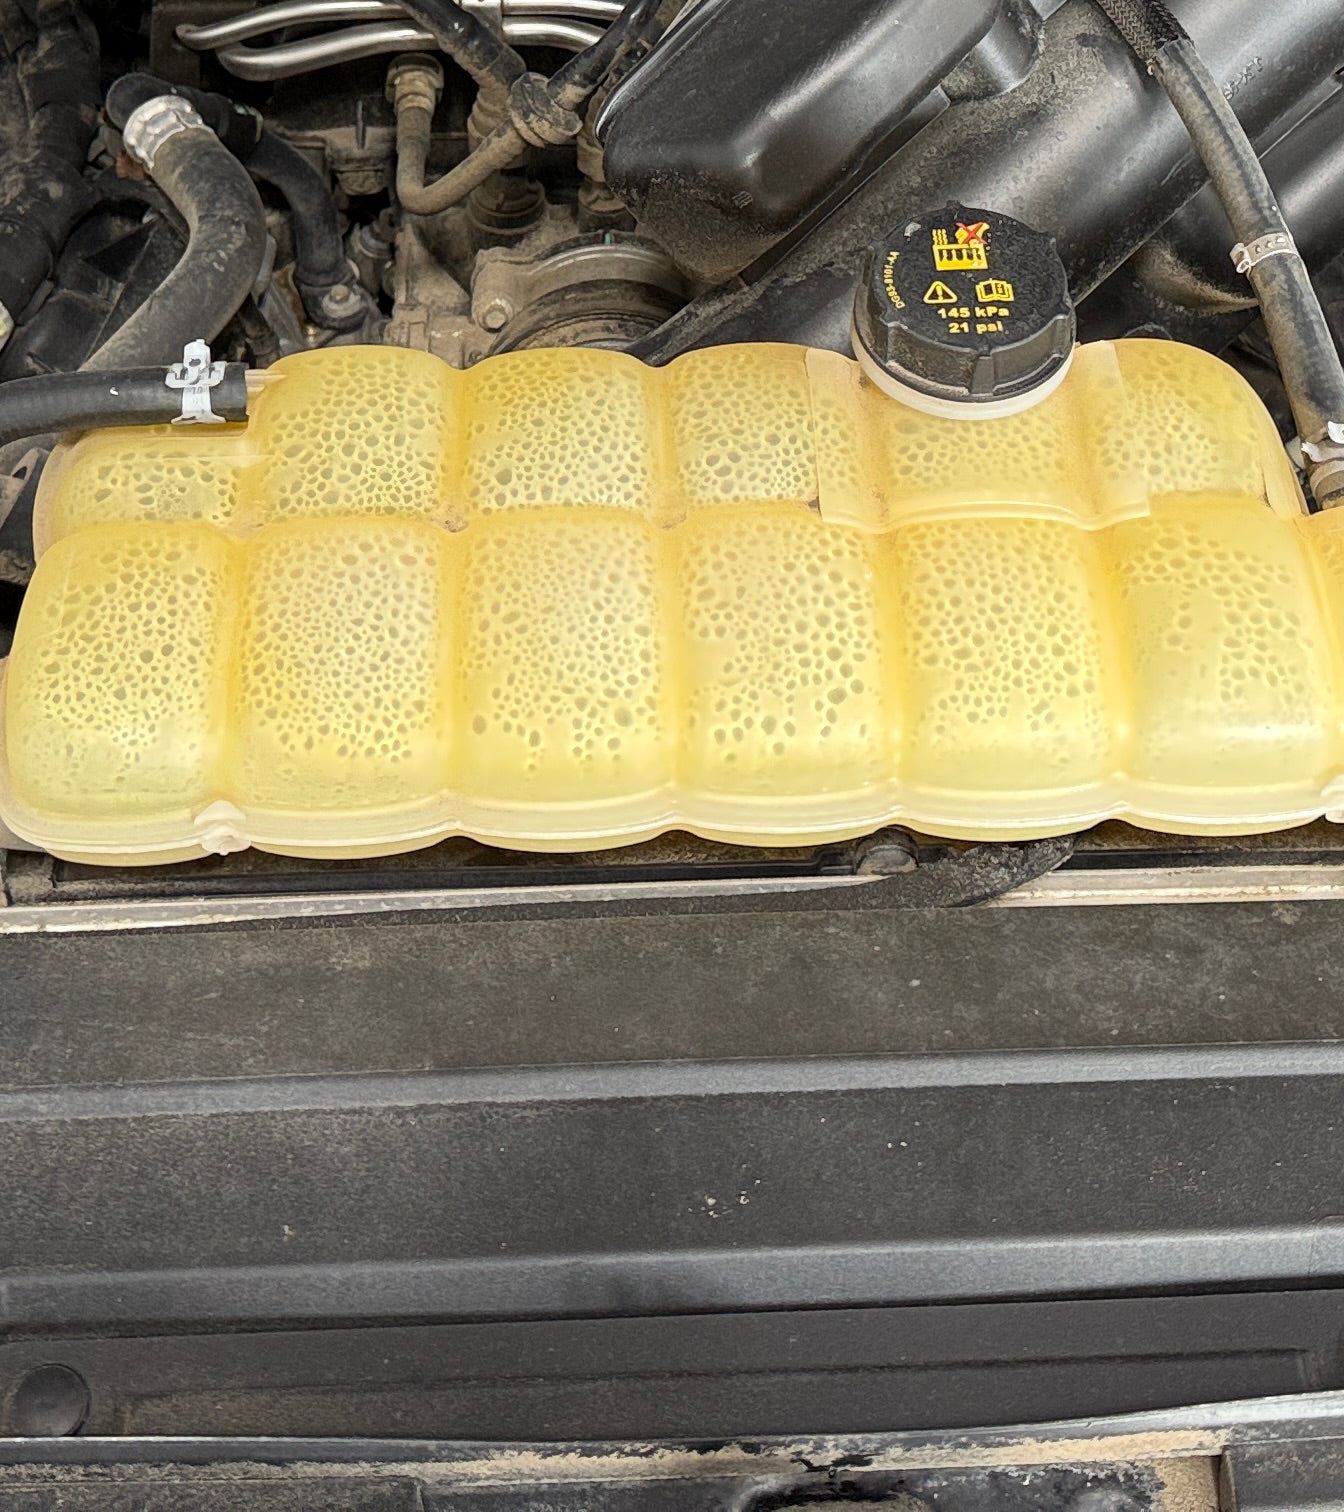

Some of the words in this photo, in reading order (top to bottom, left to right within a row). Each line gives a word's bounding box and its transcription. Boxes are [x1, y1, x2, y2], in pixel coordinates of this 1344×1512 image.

[937, 307, 971, 319] 145
[974, 305, 1010, 318] kPa
[948, 321, 970, 334] 21
